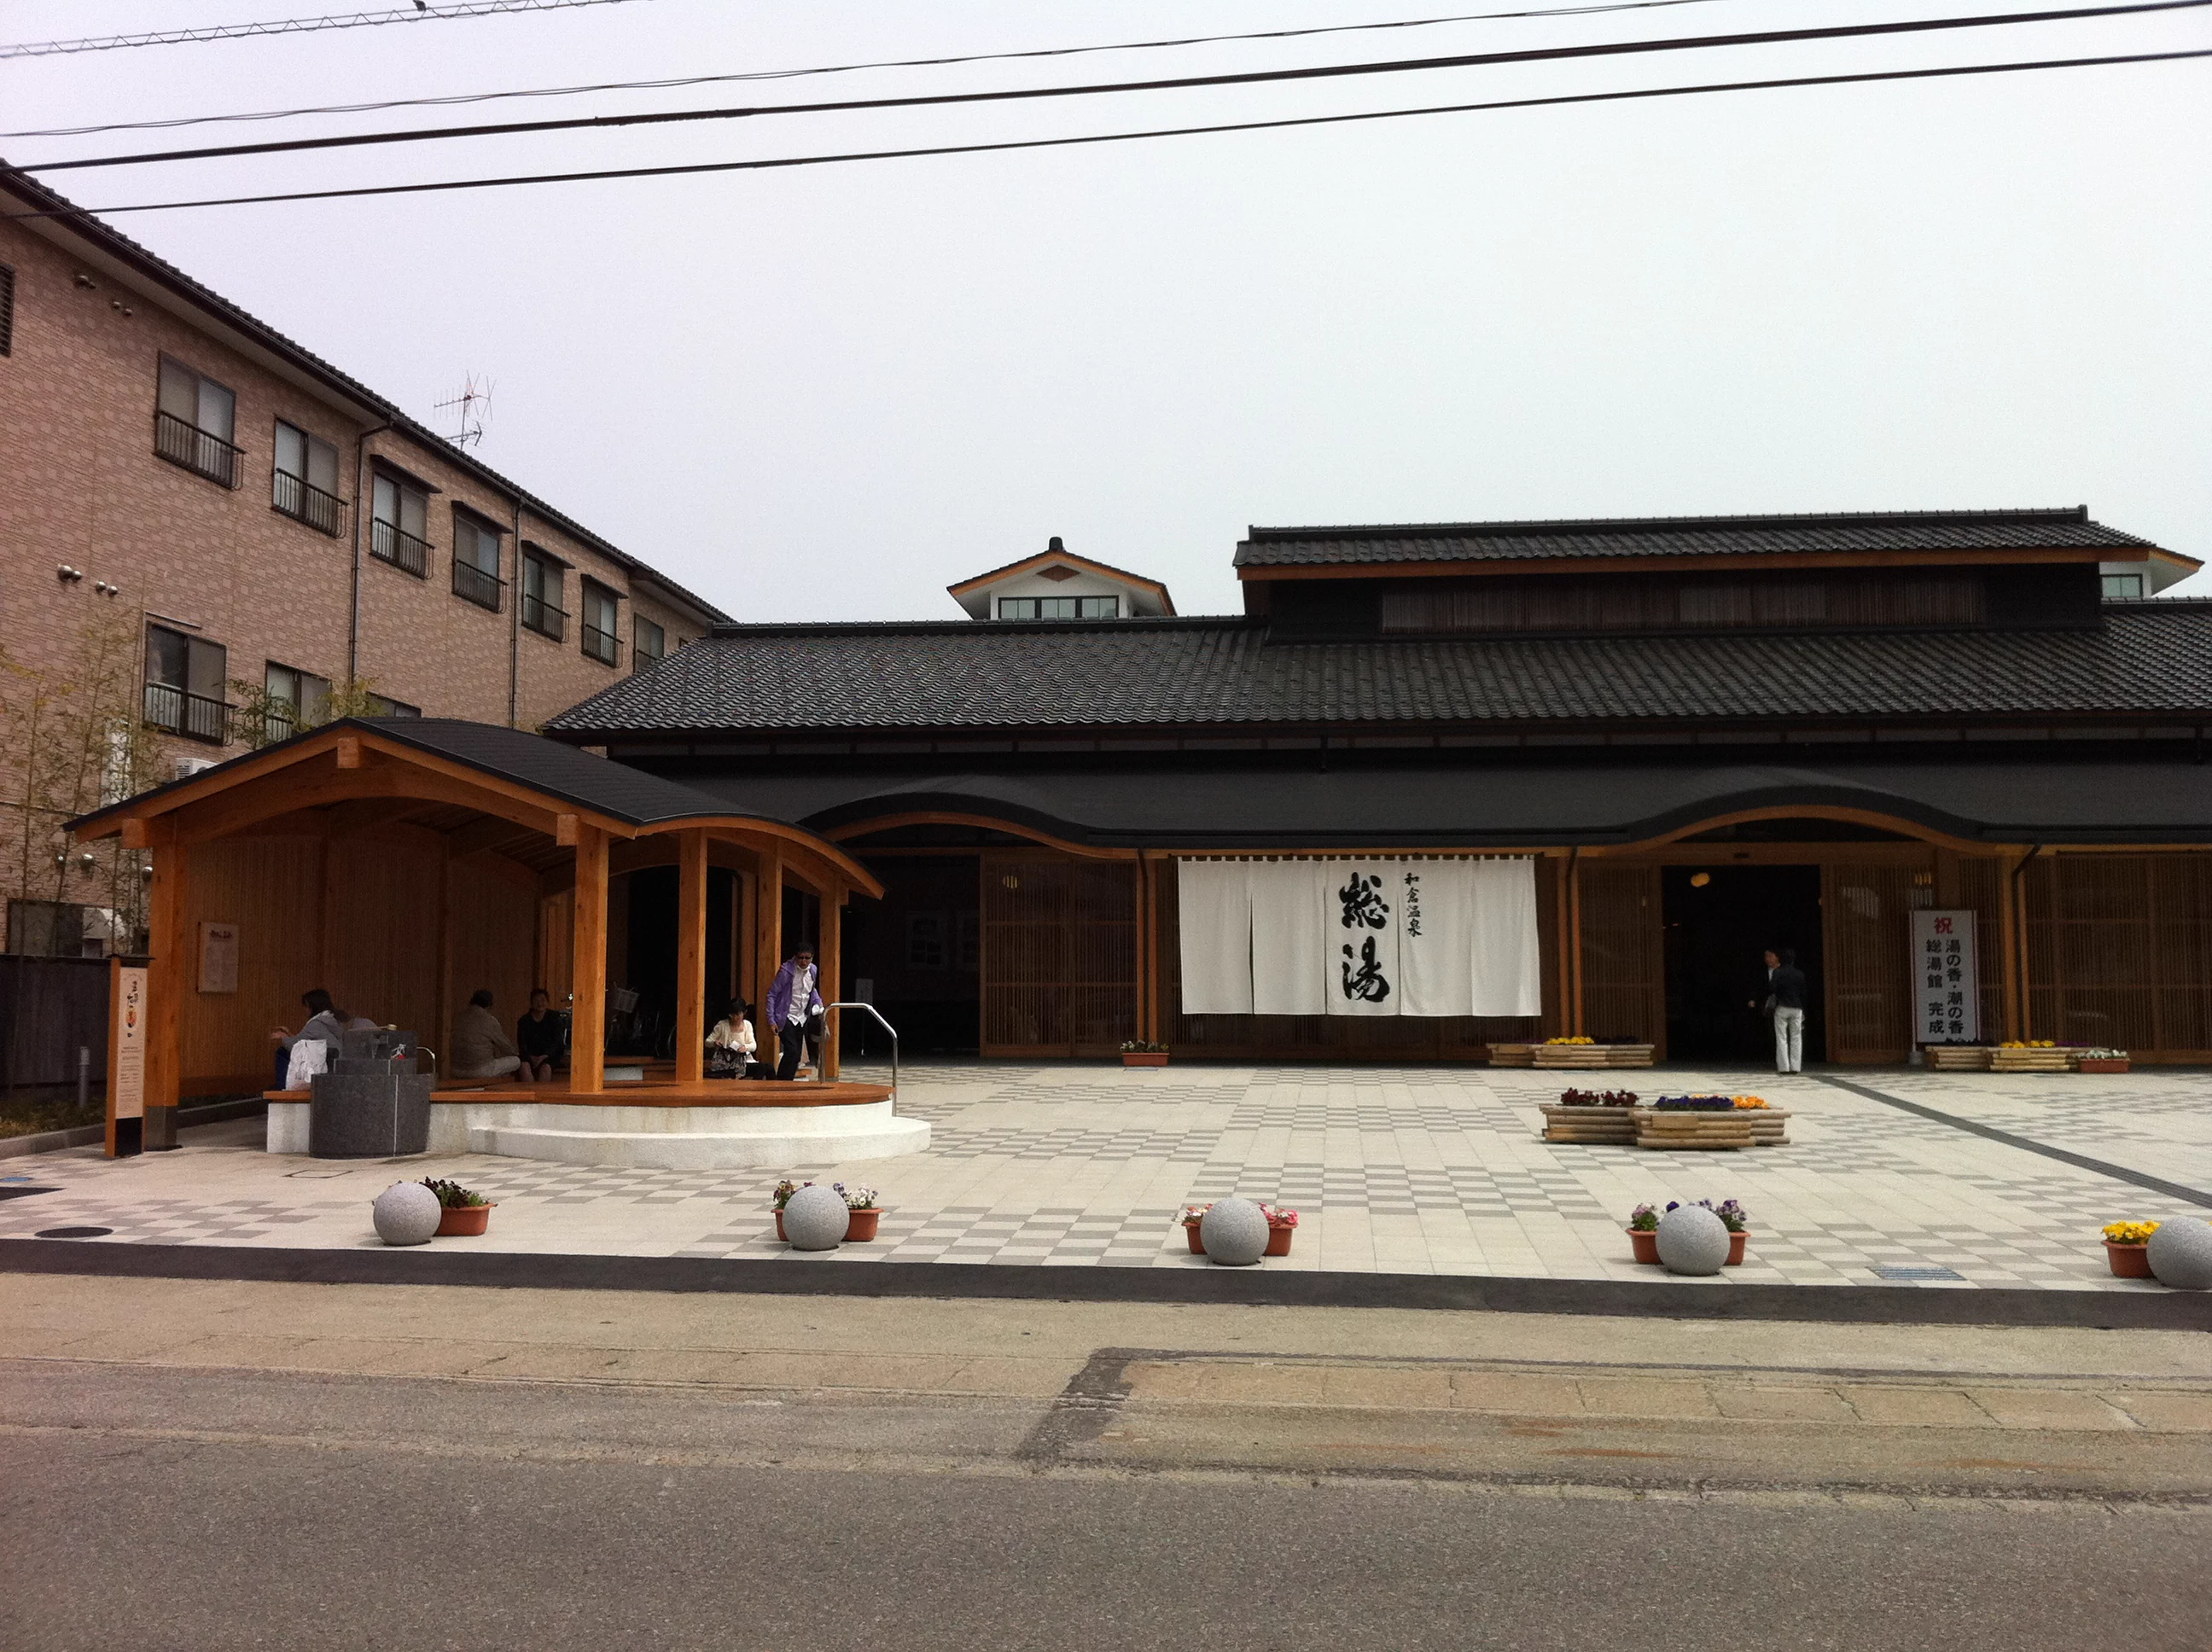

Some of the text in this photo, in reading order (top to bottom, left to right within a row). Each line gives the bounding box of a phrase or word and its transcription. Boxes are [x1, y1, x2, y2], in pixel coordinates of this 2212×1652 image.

[1338, 871, 1390, 1003] 総湯
[1404, 872, 1423, 938] 和倉温泉
[1934, 916, 1953, 935] 祝
[1925, 939, 1945, 1034] 総湯館 完成
